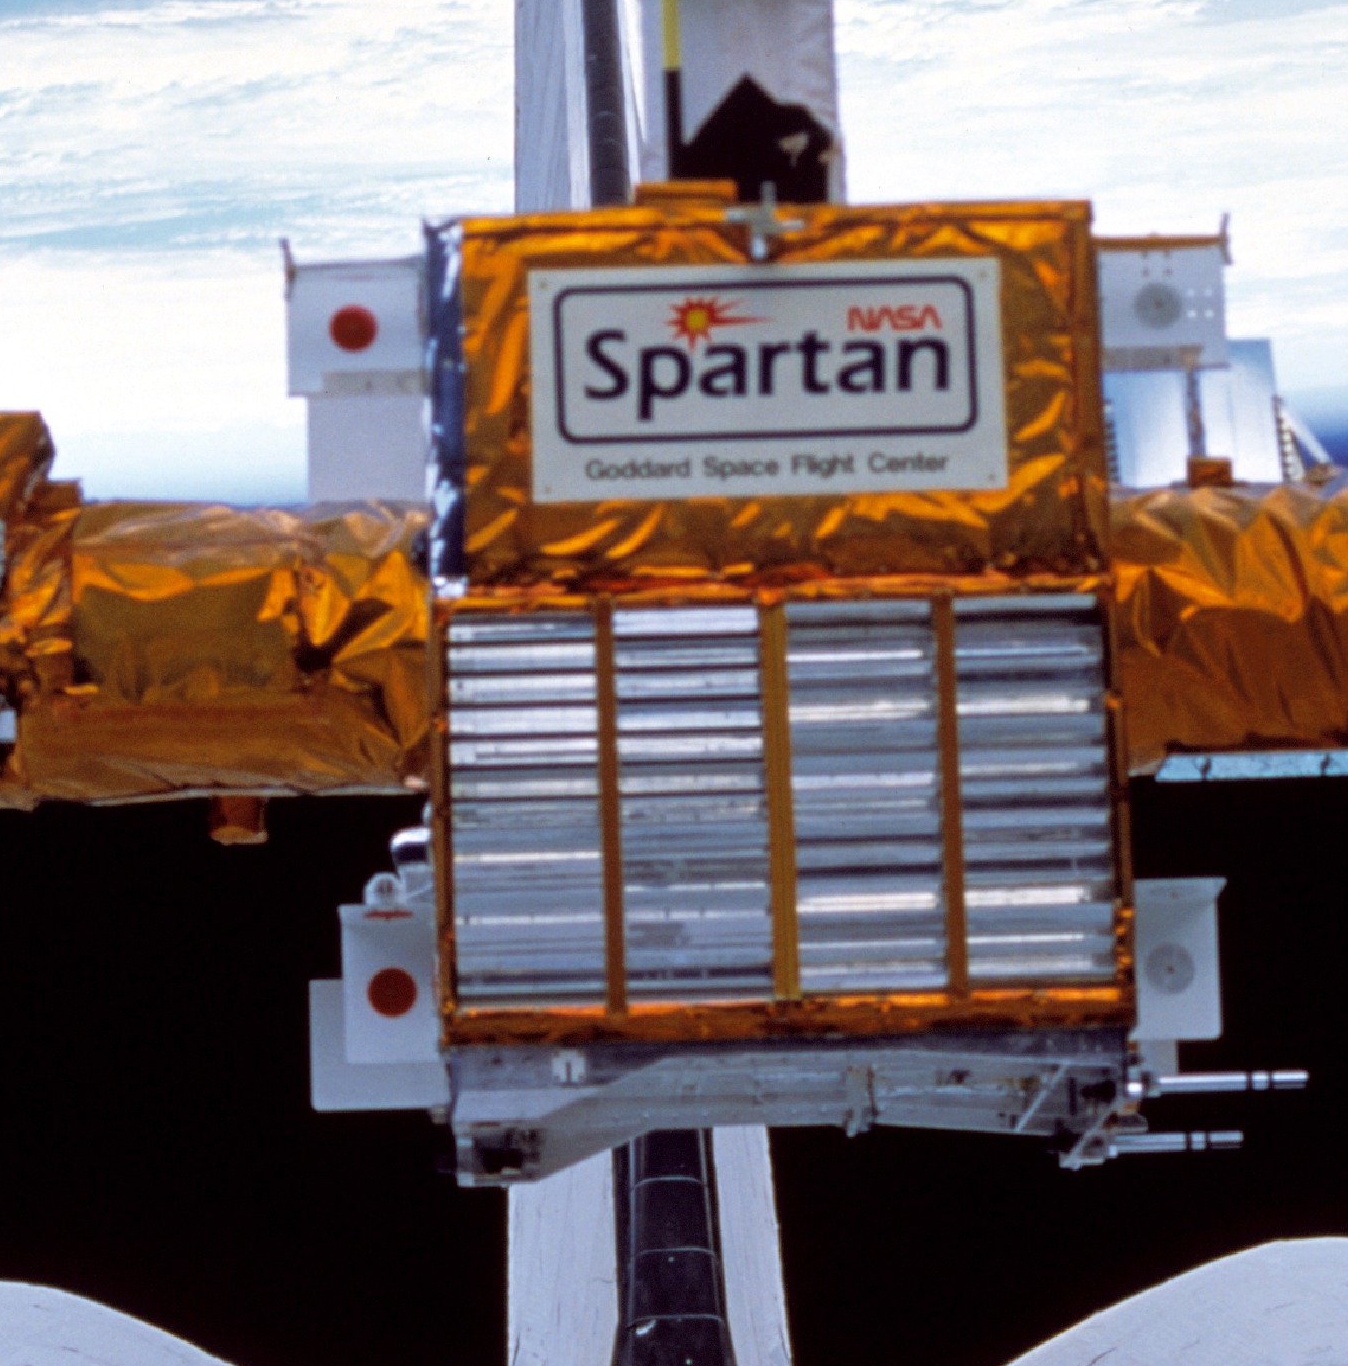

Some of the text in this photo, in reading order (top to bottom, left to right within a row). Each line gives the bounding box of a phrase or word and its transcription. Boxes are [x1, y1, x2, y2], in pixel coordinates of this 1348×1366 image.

[847, 304, 943, 332] NASA
[584, 328, 950, 422] Spartan
[585, 451, 948, 482] Goddard Space Flight Center
